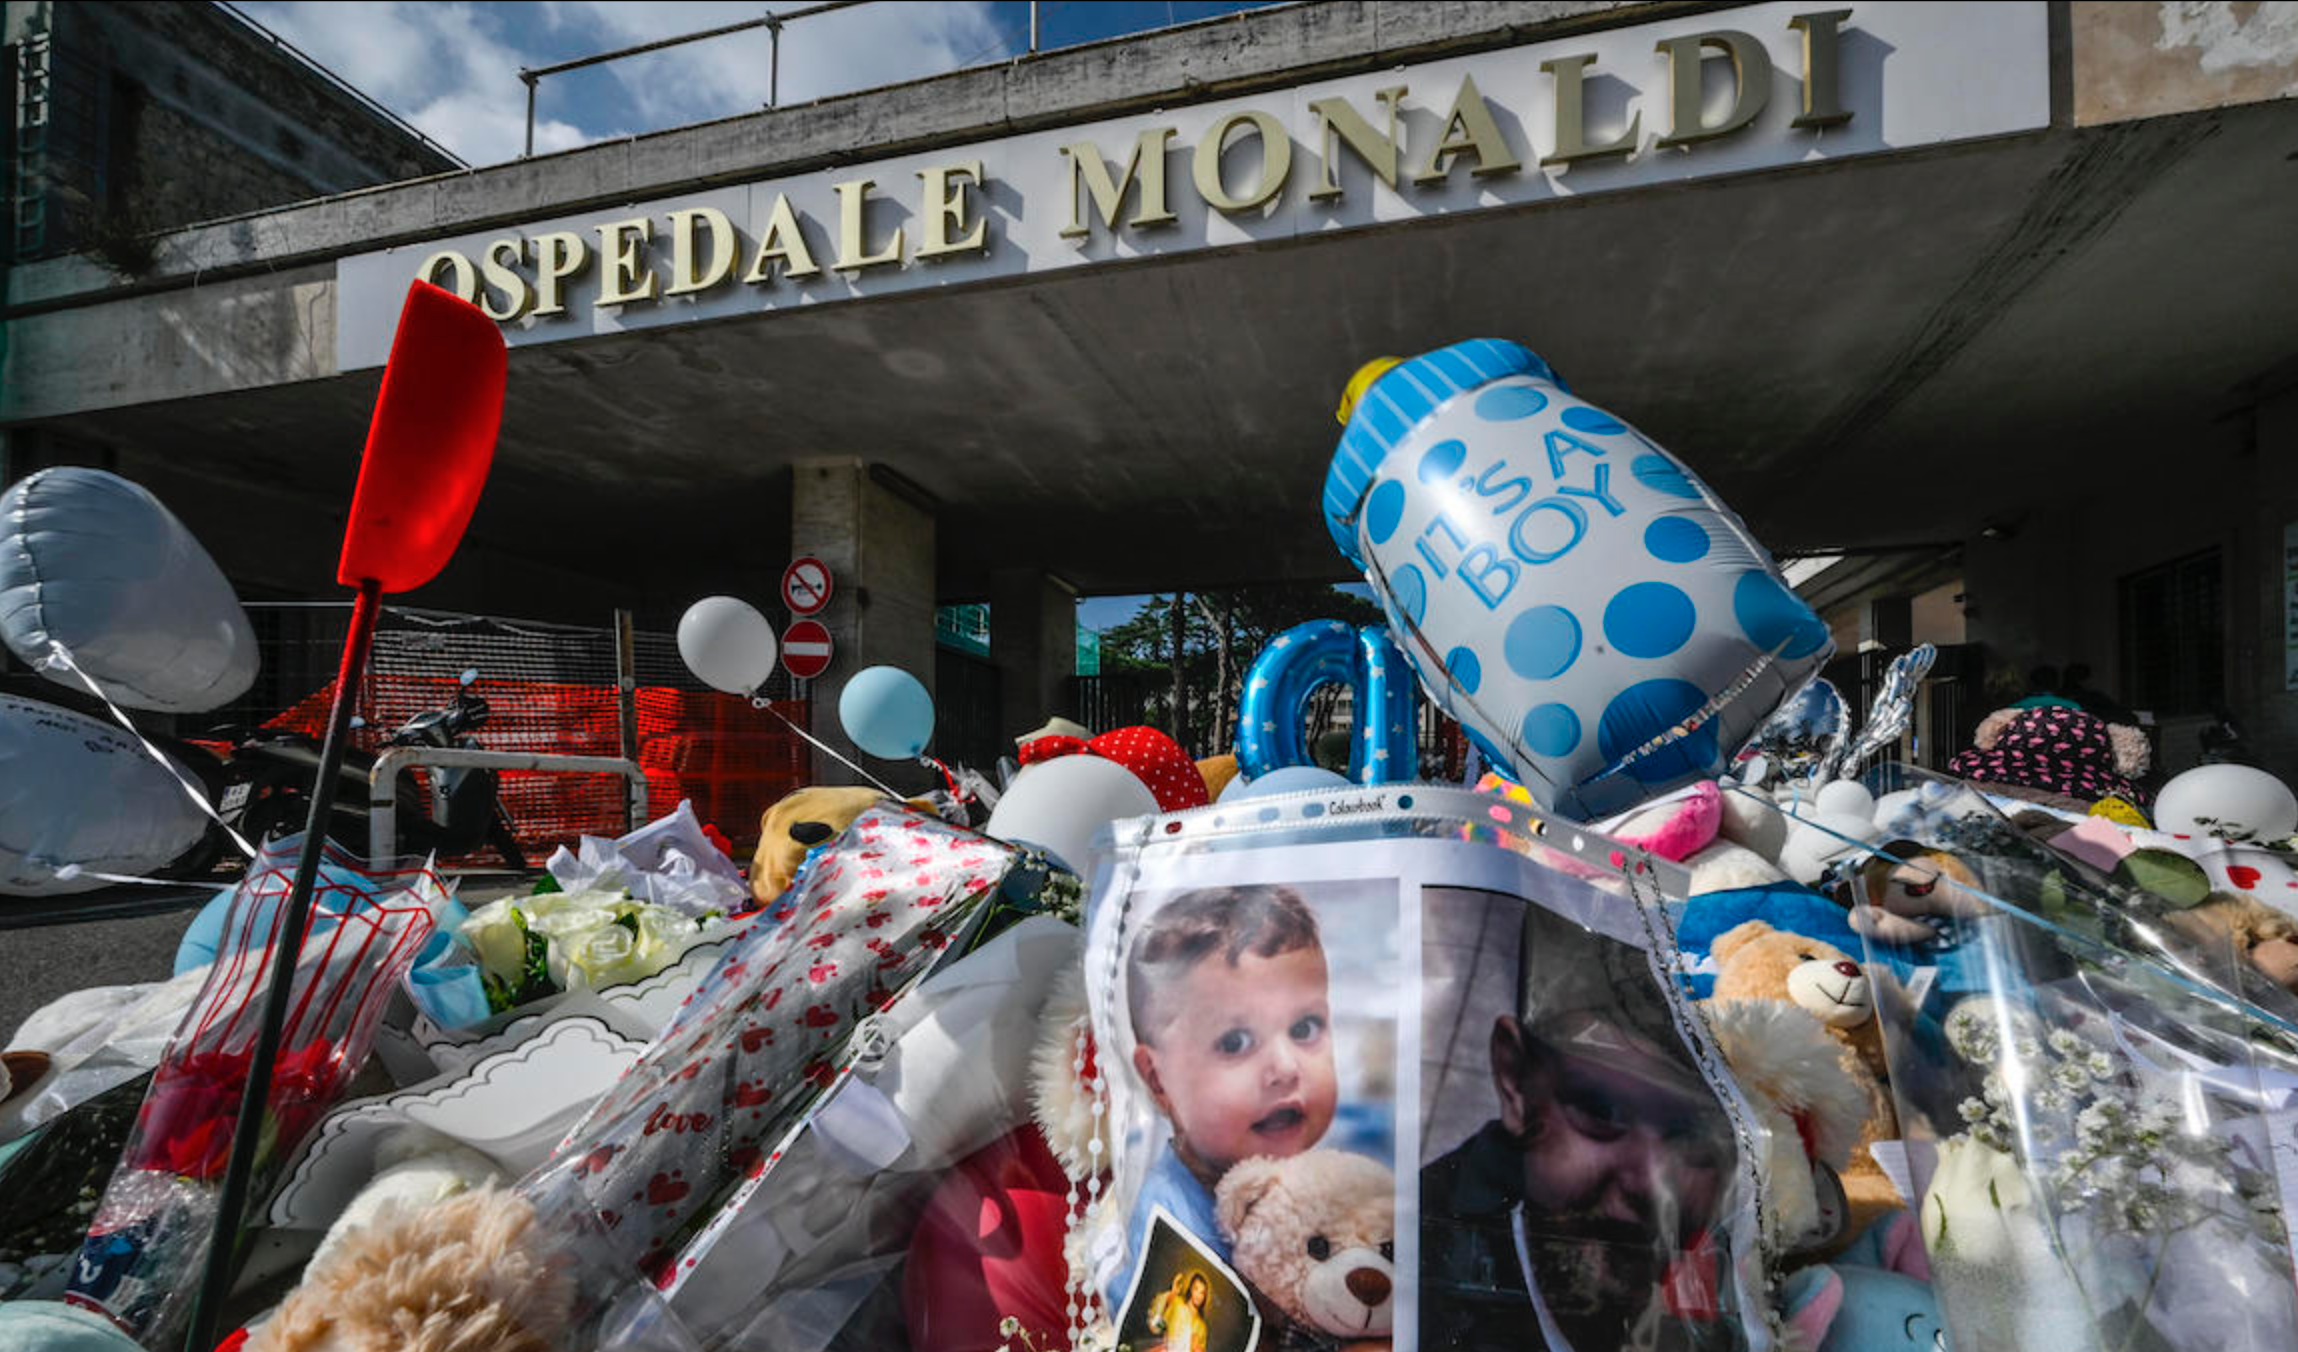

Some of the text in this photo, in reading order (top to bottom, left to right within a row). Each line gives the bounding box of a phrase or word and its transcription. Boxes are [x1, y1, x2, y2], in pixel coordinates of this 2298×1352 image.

[416, 8, 1856, 323] OSPEDALE MONALDI
[1414, 430, 1608, 581] IT'S A
[1456, 463, 1627, 611] BOY
[642, 1101, 713, 1137] love
